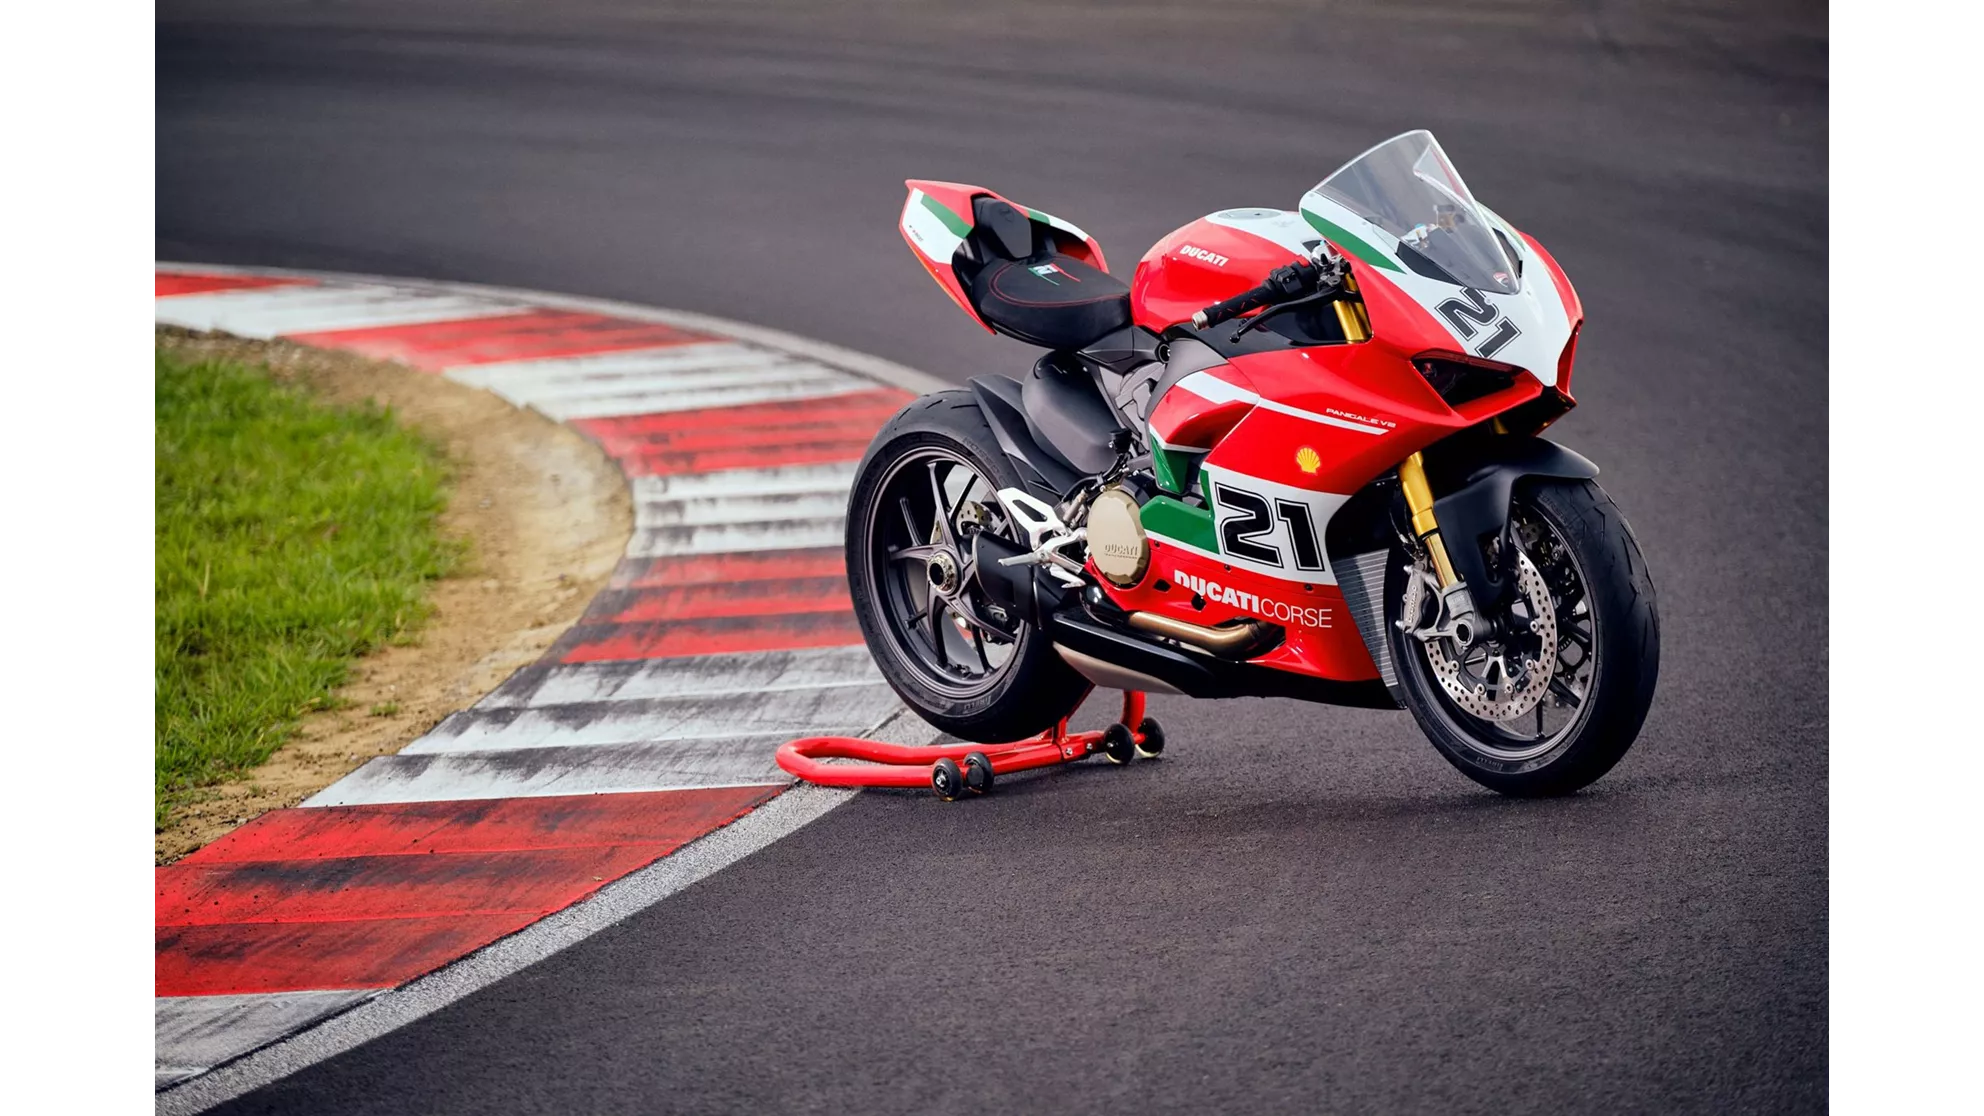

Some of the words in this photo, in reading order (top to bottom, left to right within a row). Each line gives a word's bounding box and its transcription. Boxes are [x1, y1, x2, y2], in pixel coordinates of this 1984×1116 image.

[1180, 244, 1229, 267] DUCATI
[1434, 285, 1522, 360] 21
[1326, 407, 1379, 425] PANIGALE
[1380, 419, 1396, 429] V2
[1214, 481, 1325, 572] 21
[1104, 543, 1138, 556] DUCATI
